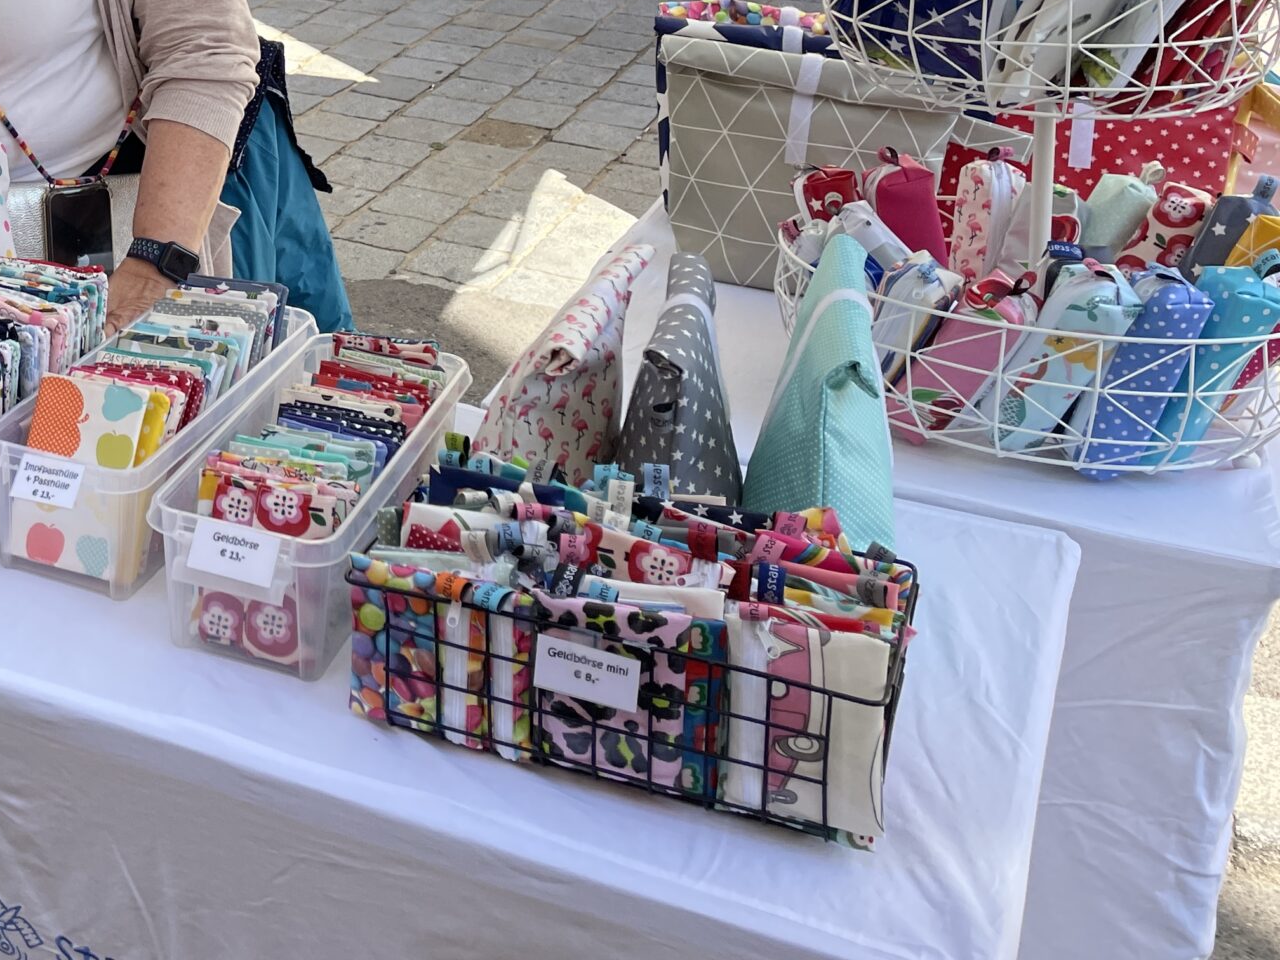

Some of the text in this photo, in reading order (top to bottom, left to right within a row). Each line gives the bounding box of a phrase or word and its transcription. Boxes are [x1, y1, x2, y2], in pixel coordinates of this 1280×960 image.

[24, 461, 79, 479] Impfpasshülle
[26, 474, 70, 490] + Passhülle
[212, 531, 260, 550] Geldbörse
[220, 548, 227, 557] €
[547, 646, 630, 677] Geldbörse mini
[574, 669, 582, 679] €
